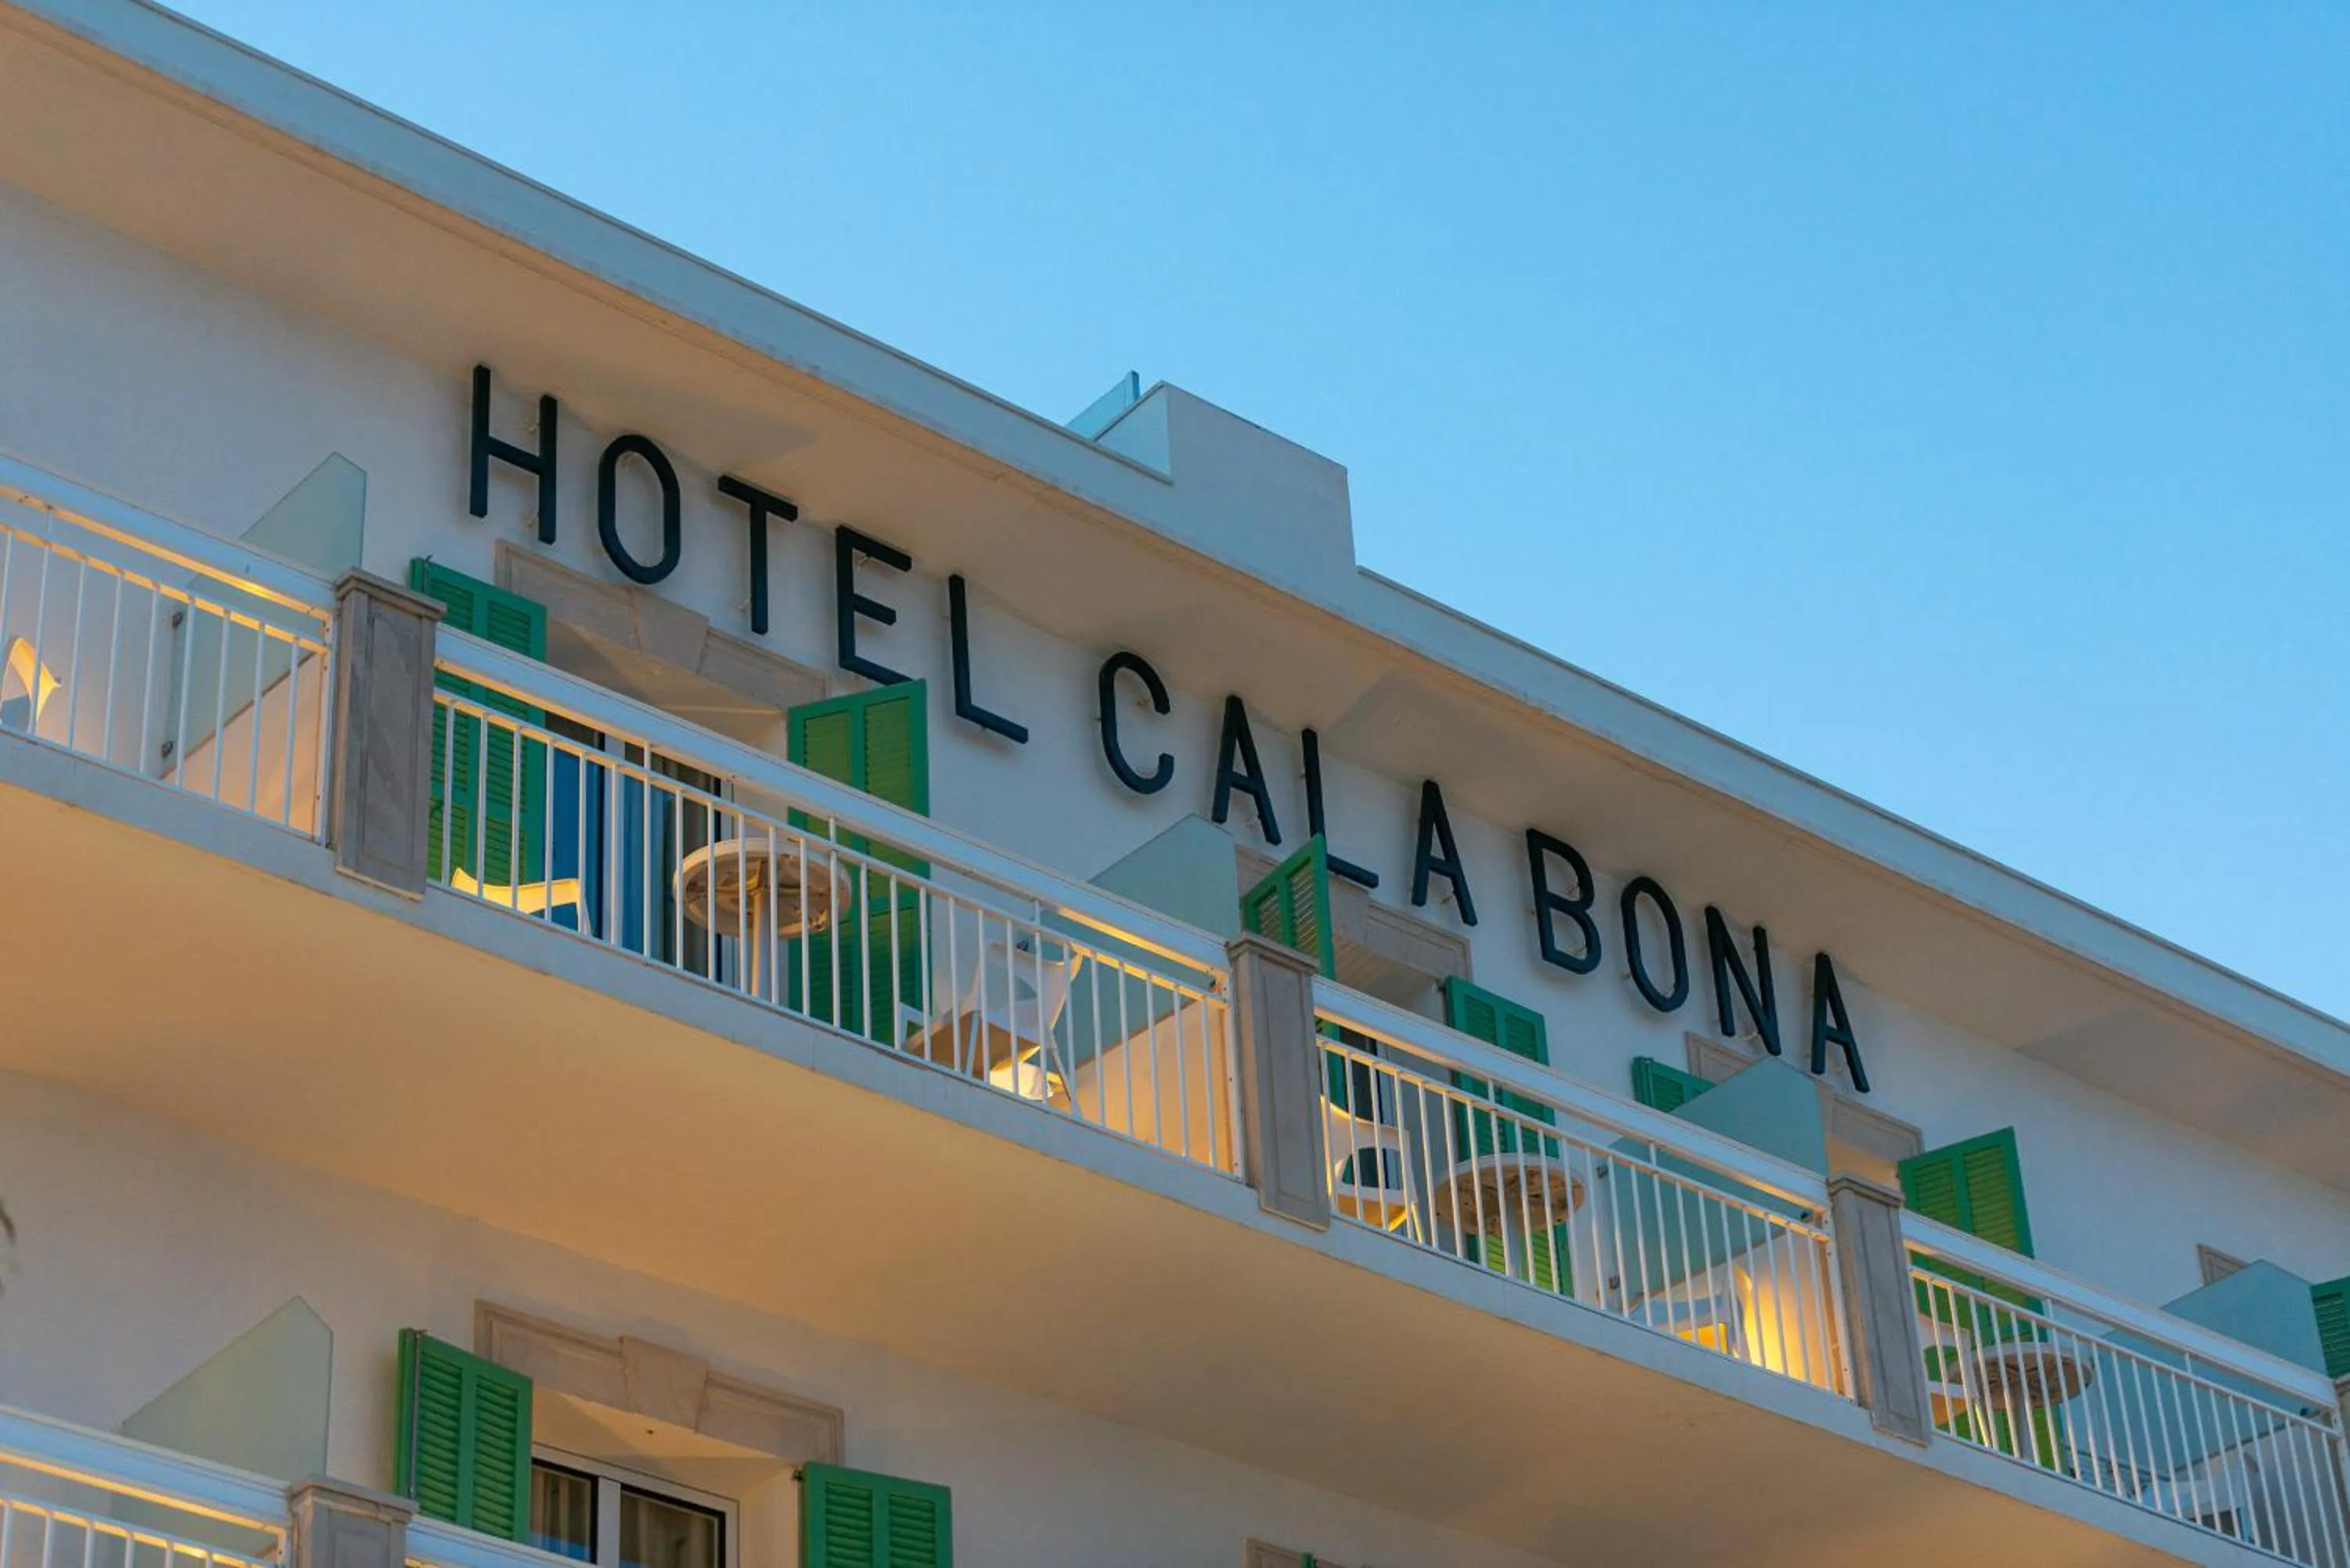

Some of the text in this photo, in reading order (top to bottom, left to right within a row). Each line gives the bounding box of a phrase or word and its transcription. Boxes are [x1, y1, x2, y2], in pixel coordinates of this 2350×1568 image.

[469, 363, 1871, 1094] HOTEL CALA BONA
